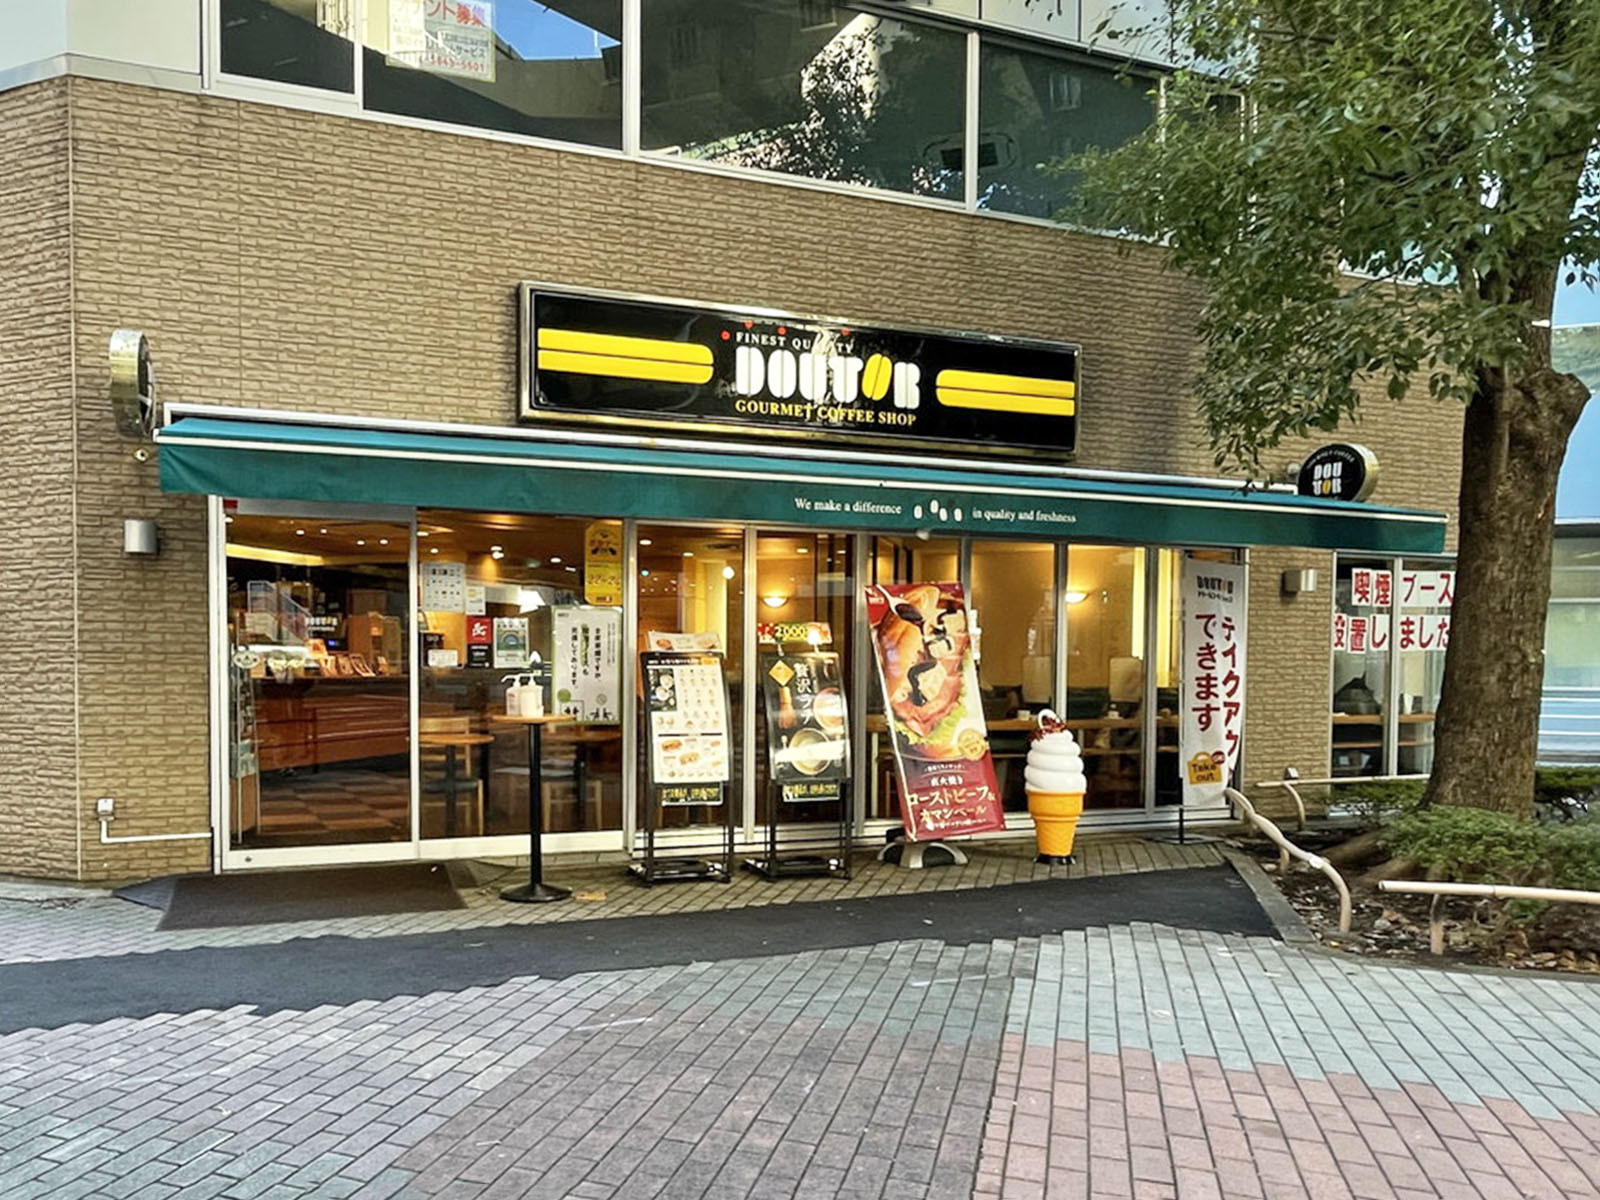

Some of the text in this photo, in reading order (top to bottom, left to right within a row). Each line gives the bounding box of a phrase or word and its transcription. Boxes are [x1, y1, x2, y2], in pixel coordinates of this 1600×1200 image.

[735, 331, 786, 347] FINEST
[735, 345, 921, 409] DOUTOR
[734, 399, 917, 426] GOURMET COFFEE SHOP
[794, 497, 1077, 523] We make a difference in quality and freshness
[1192, 612, 1221, 732] できます
[1221, 616, 1240, 766] テイクアウ
